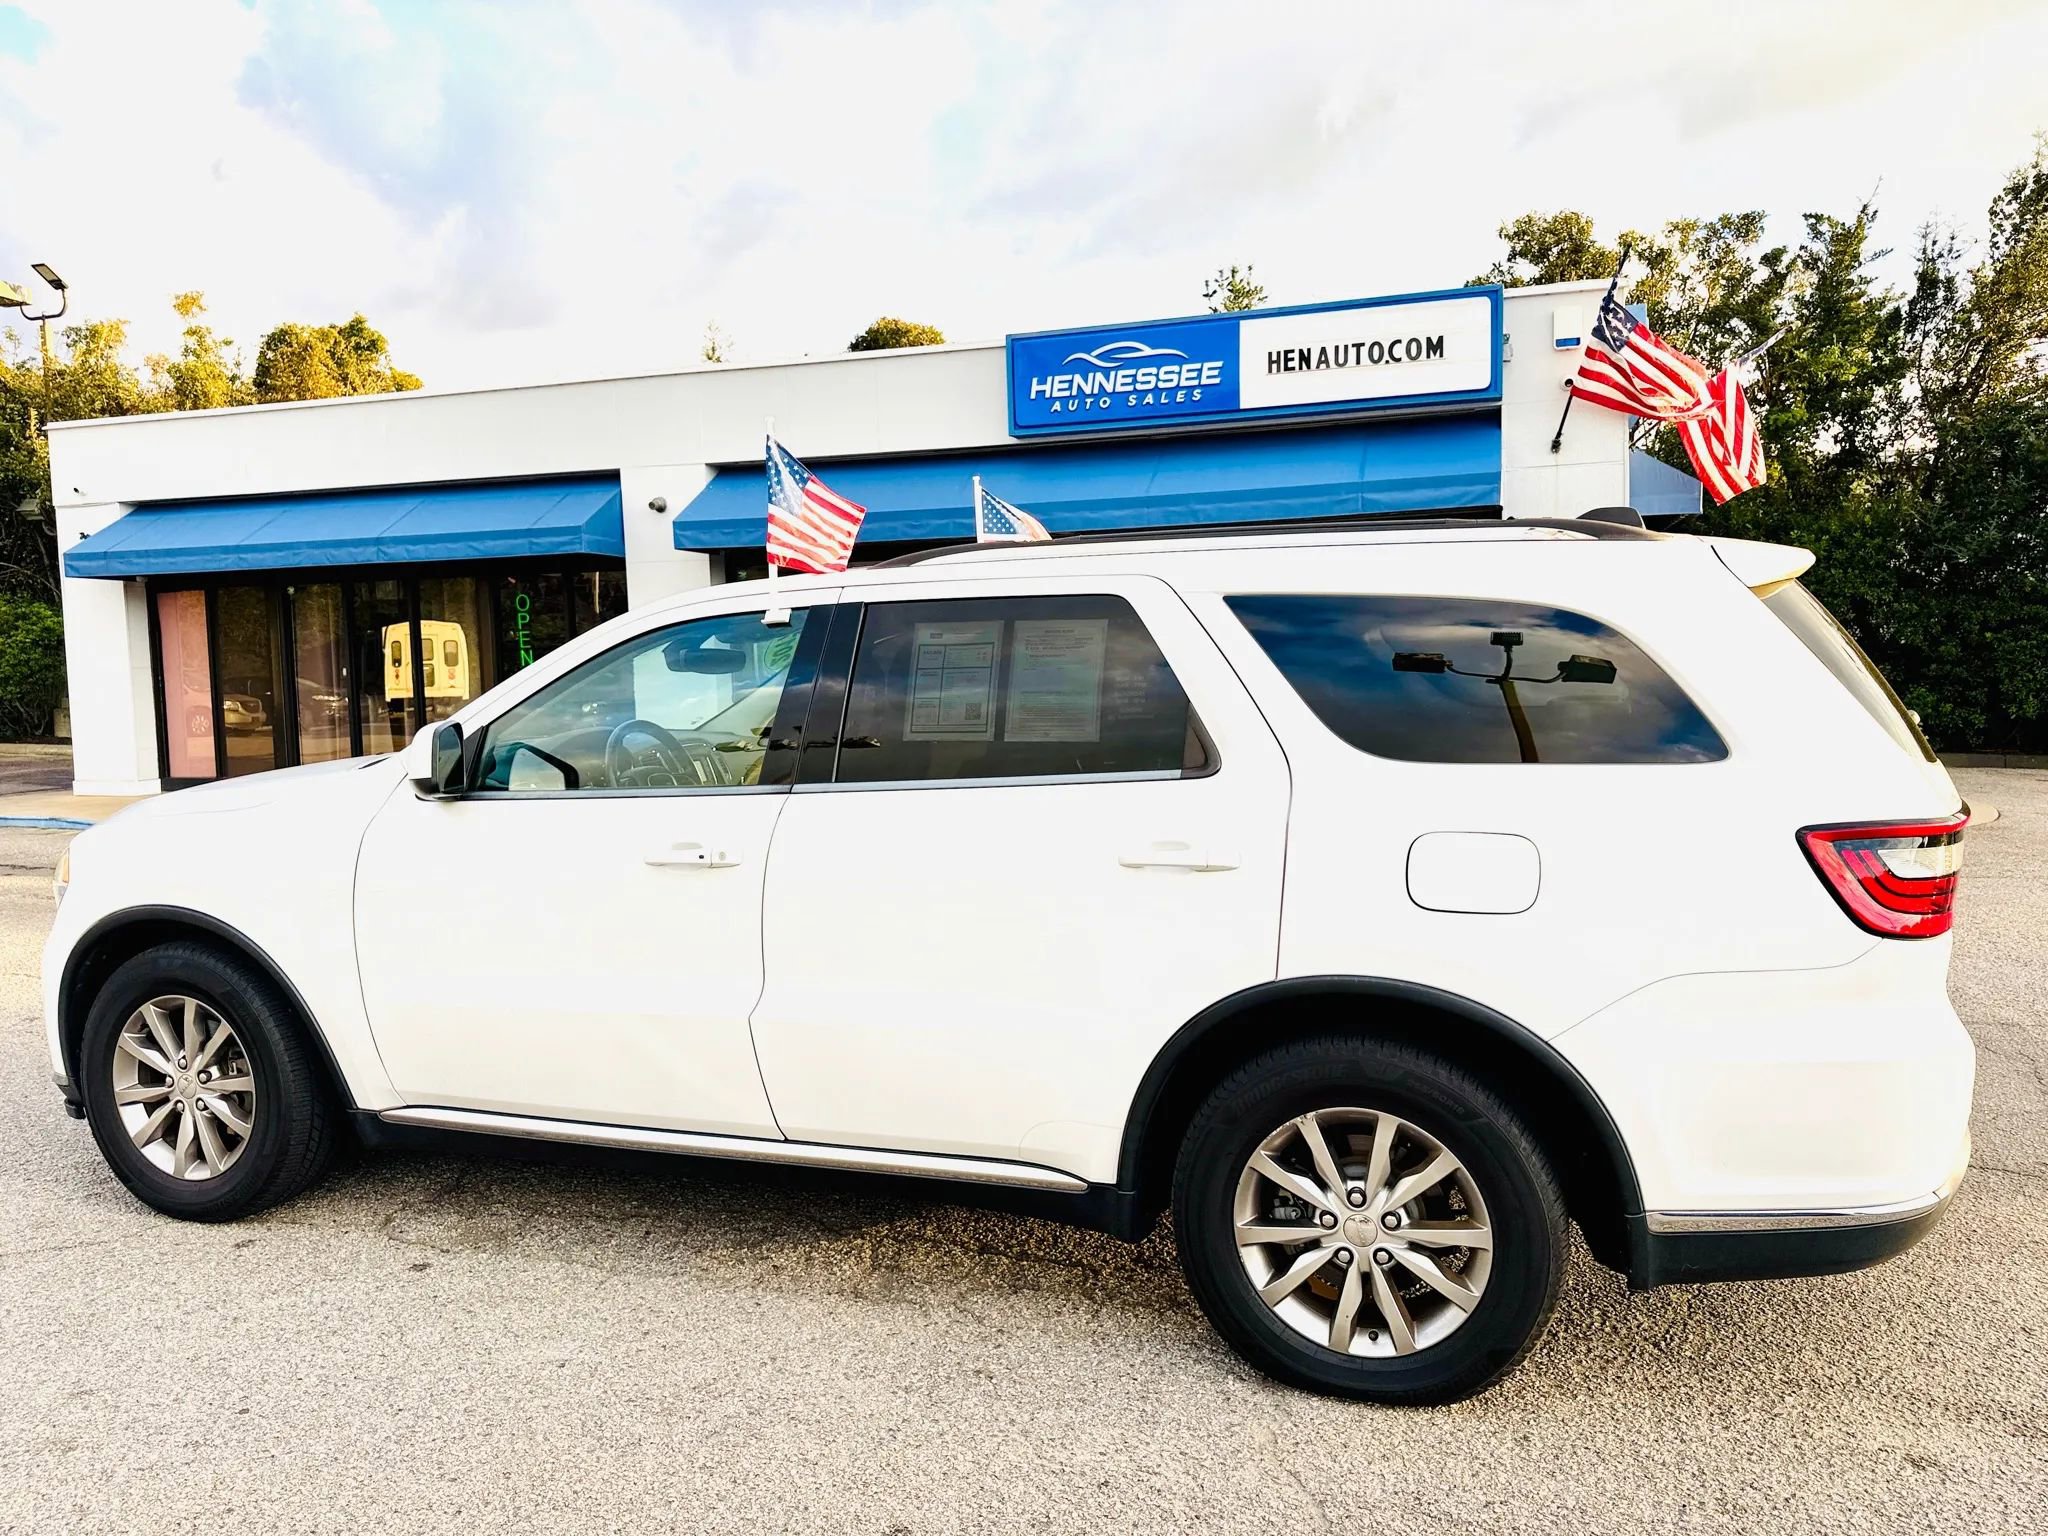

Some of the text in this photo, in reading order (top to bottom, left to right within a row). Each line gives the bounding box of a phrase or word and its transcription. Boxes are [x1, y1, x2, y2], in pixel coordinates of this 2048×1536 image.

[1267, 335, 1444, 374] HENAUTO.COM
[1029, 361, 1224, 400] HENNESSEE
[1050, 389, 1203, 413] AUTO SALES
[515, 593, 534, 667] OPEN
